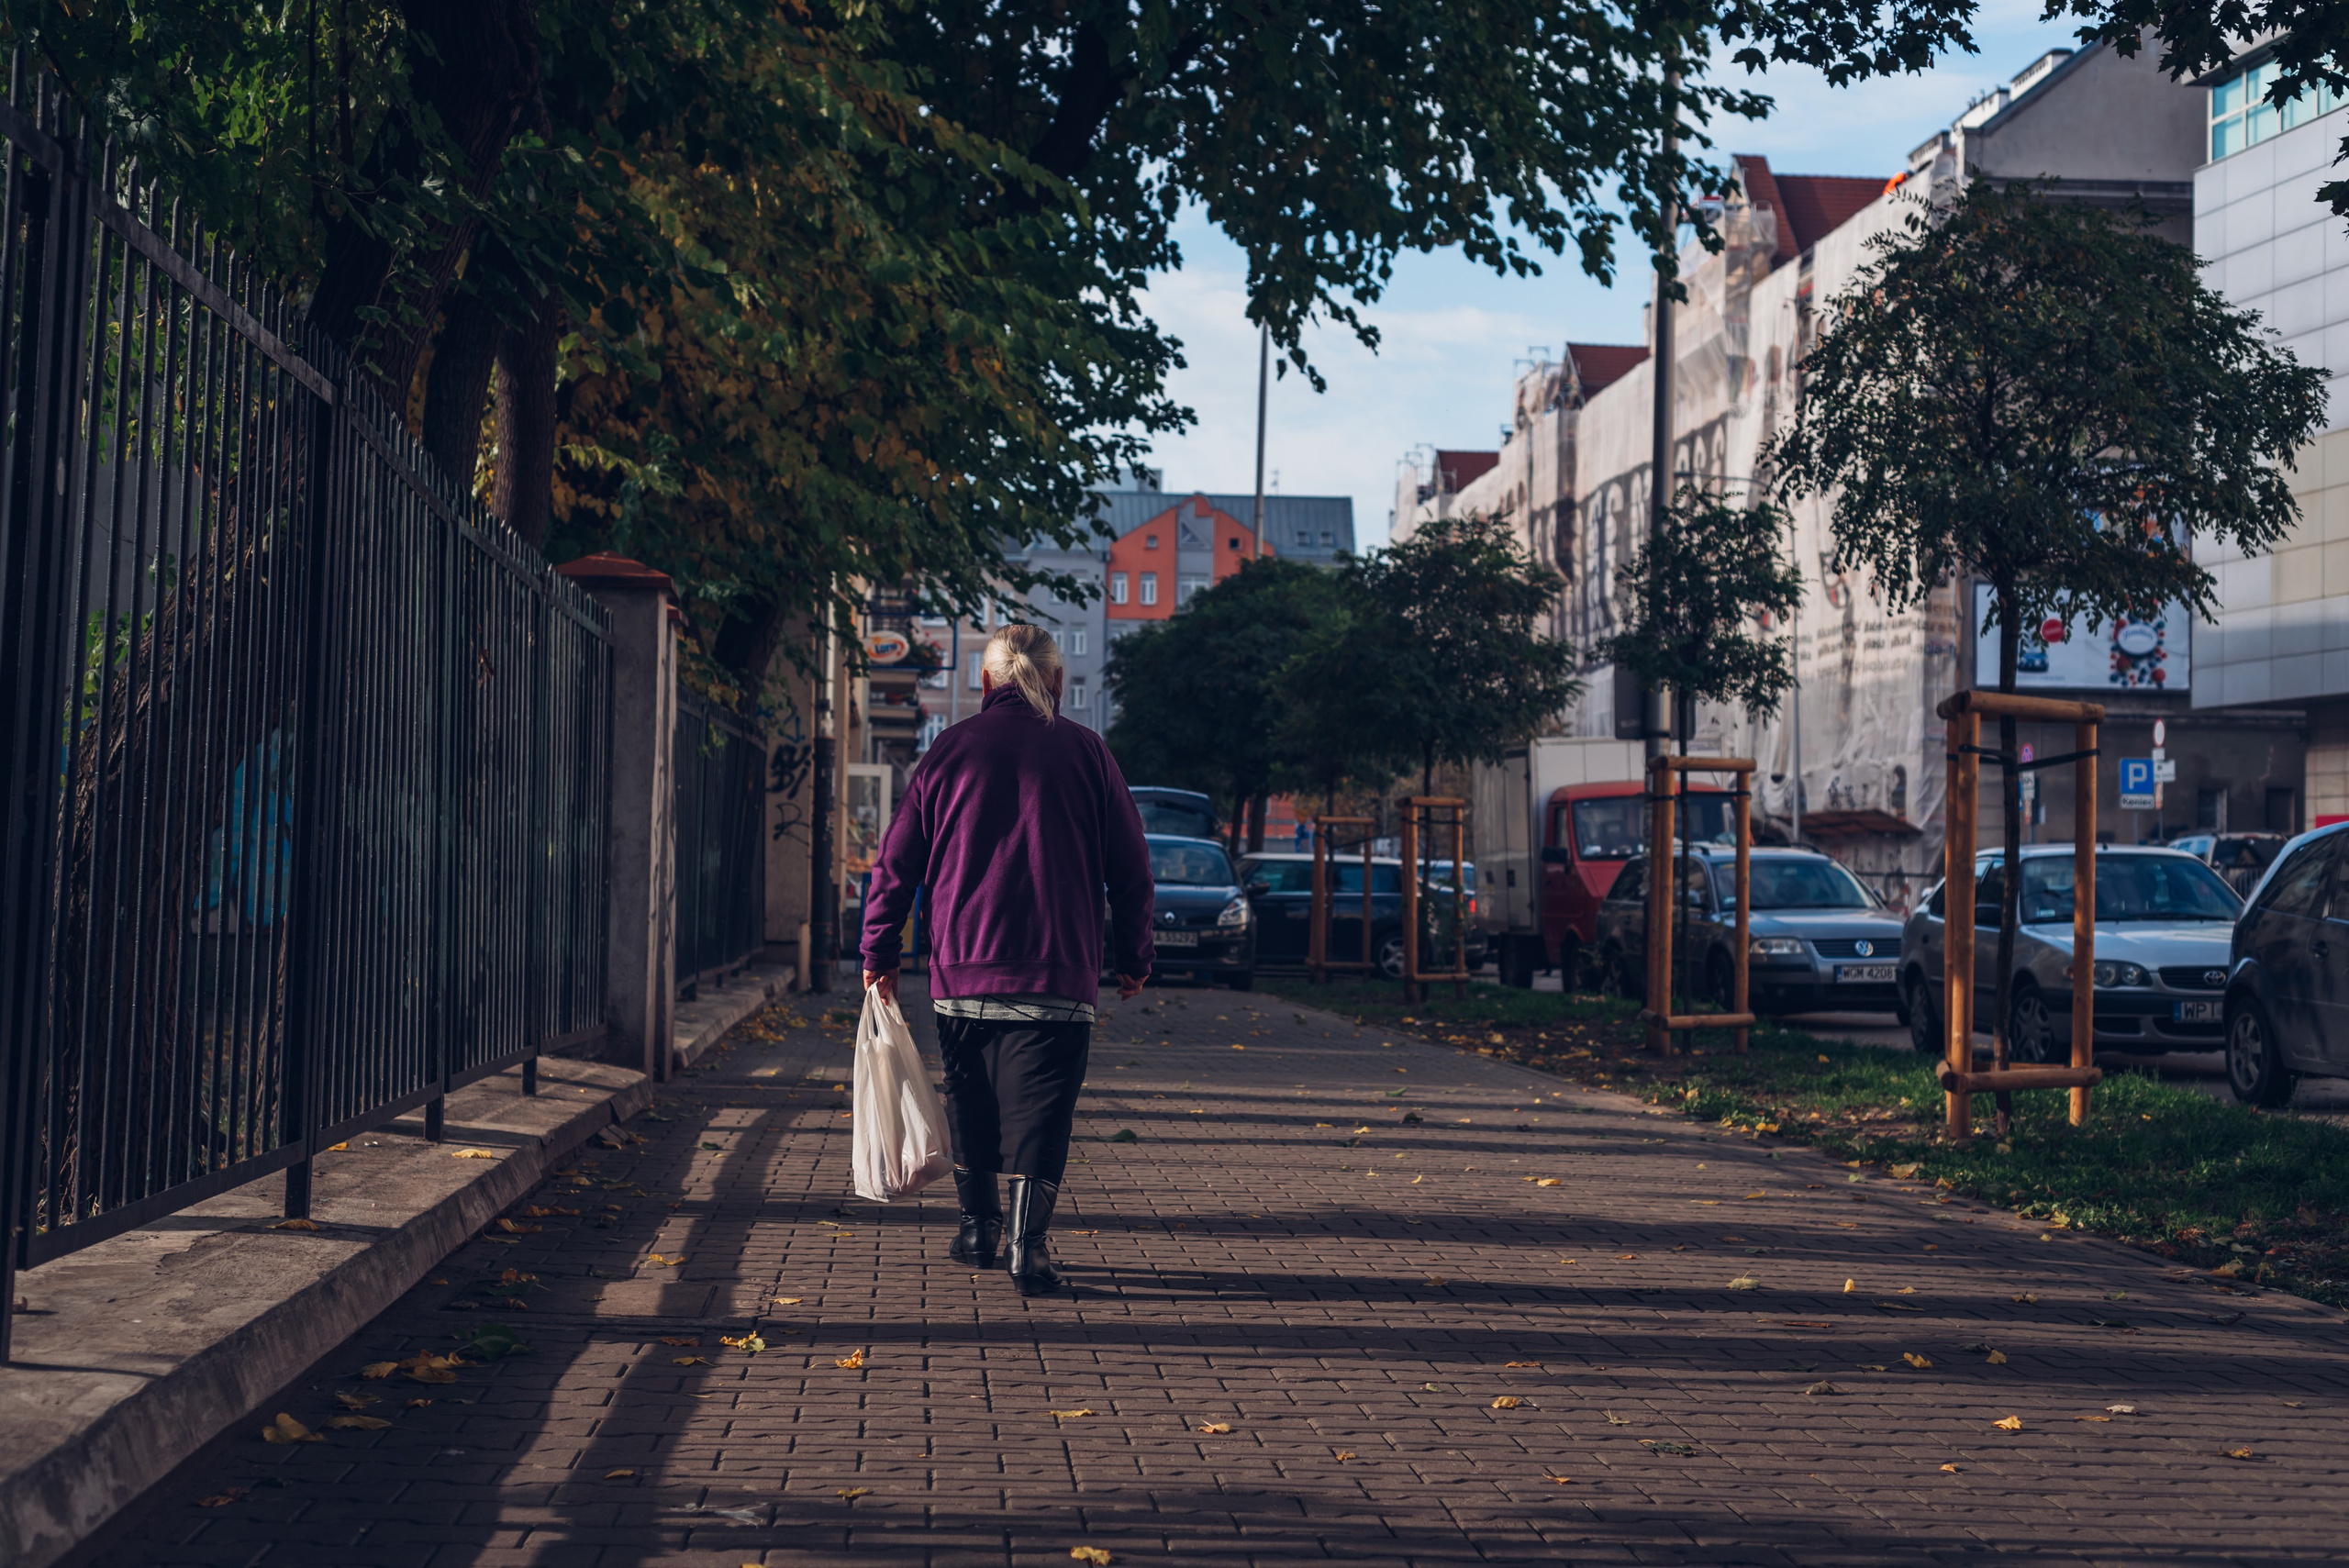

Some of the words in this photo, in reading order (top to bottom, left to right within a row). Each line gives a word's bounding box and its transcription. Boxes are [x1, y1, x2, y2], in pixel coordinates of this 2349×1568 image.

[2129, 762, 2147, 790] P
[2122, 796, 2152, 806] Koniec
[1842, 966, 1865, 979] WGM
